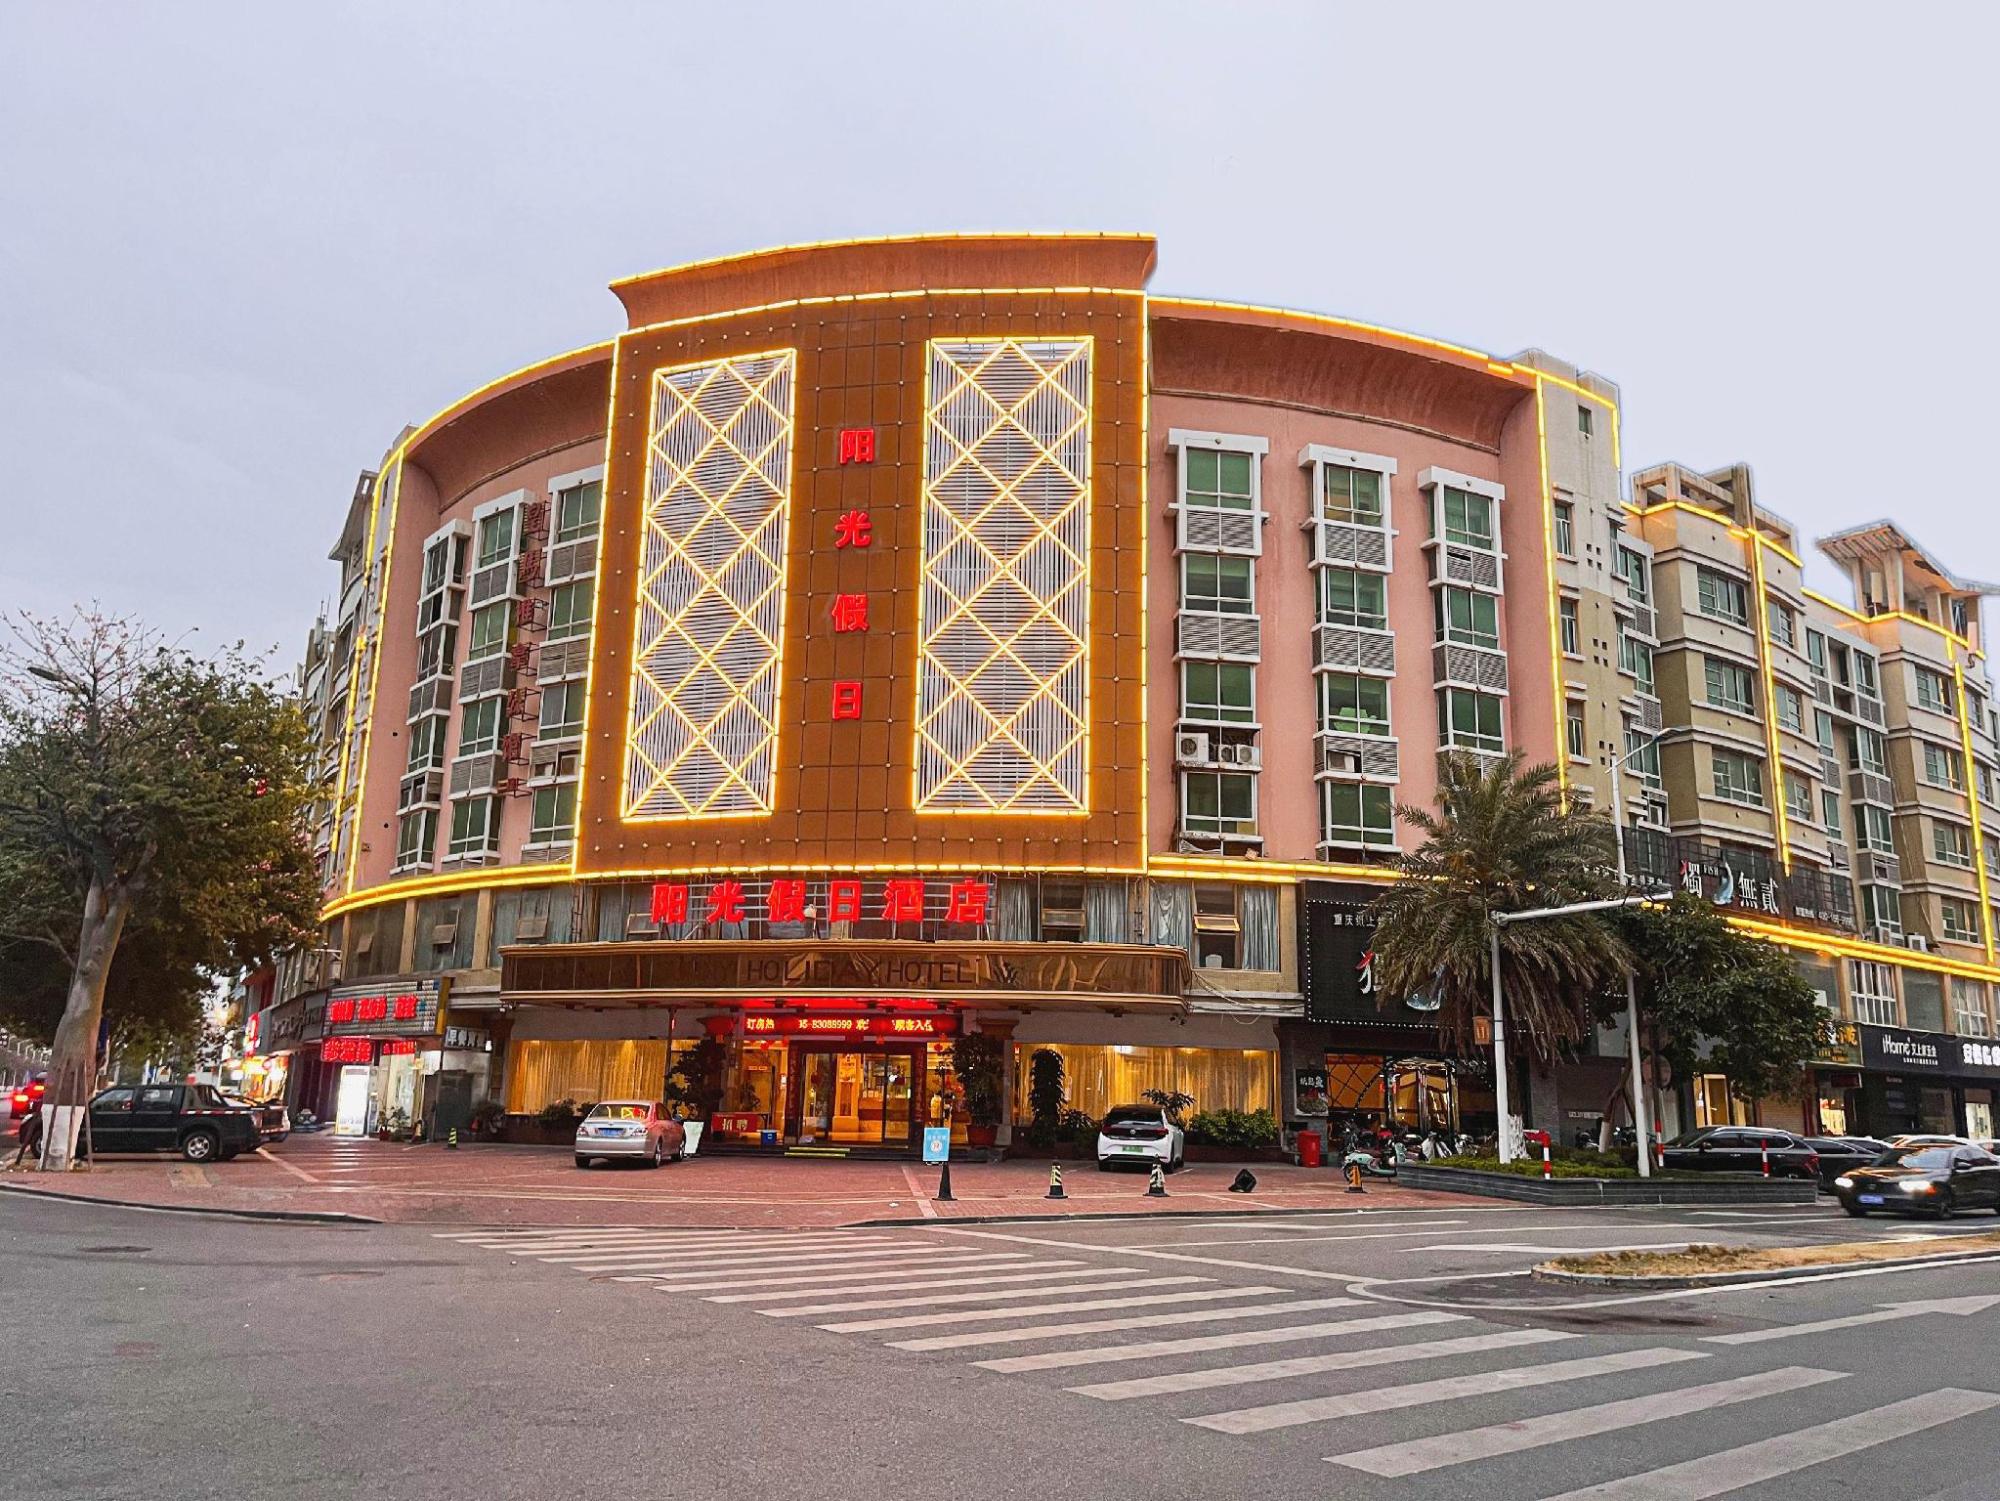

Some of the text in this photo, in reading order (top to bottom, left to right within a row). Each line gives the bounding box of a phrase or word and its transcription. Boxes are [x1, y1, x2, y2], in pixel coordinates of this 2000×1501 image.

[832, 428, 875, 720] 阳光假日
[651, 879, 989, 924] 阳光假日酒店
[748, 959, 882, 985] HOLIDAY
[887, 960, 973, 984] HOTEL
[892, 1018, 934, 1031] 顾客入住
